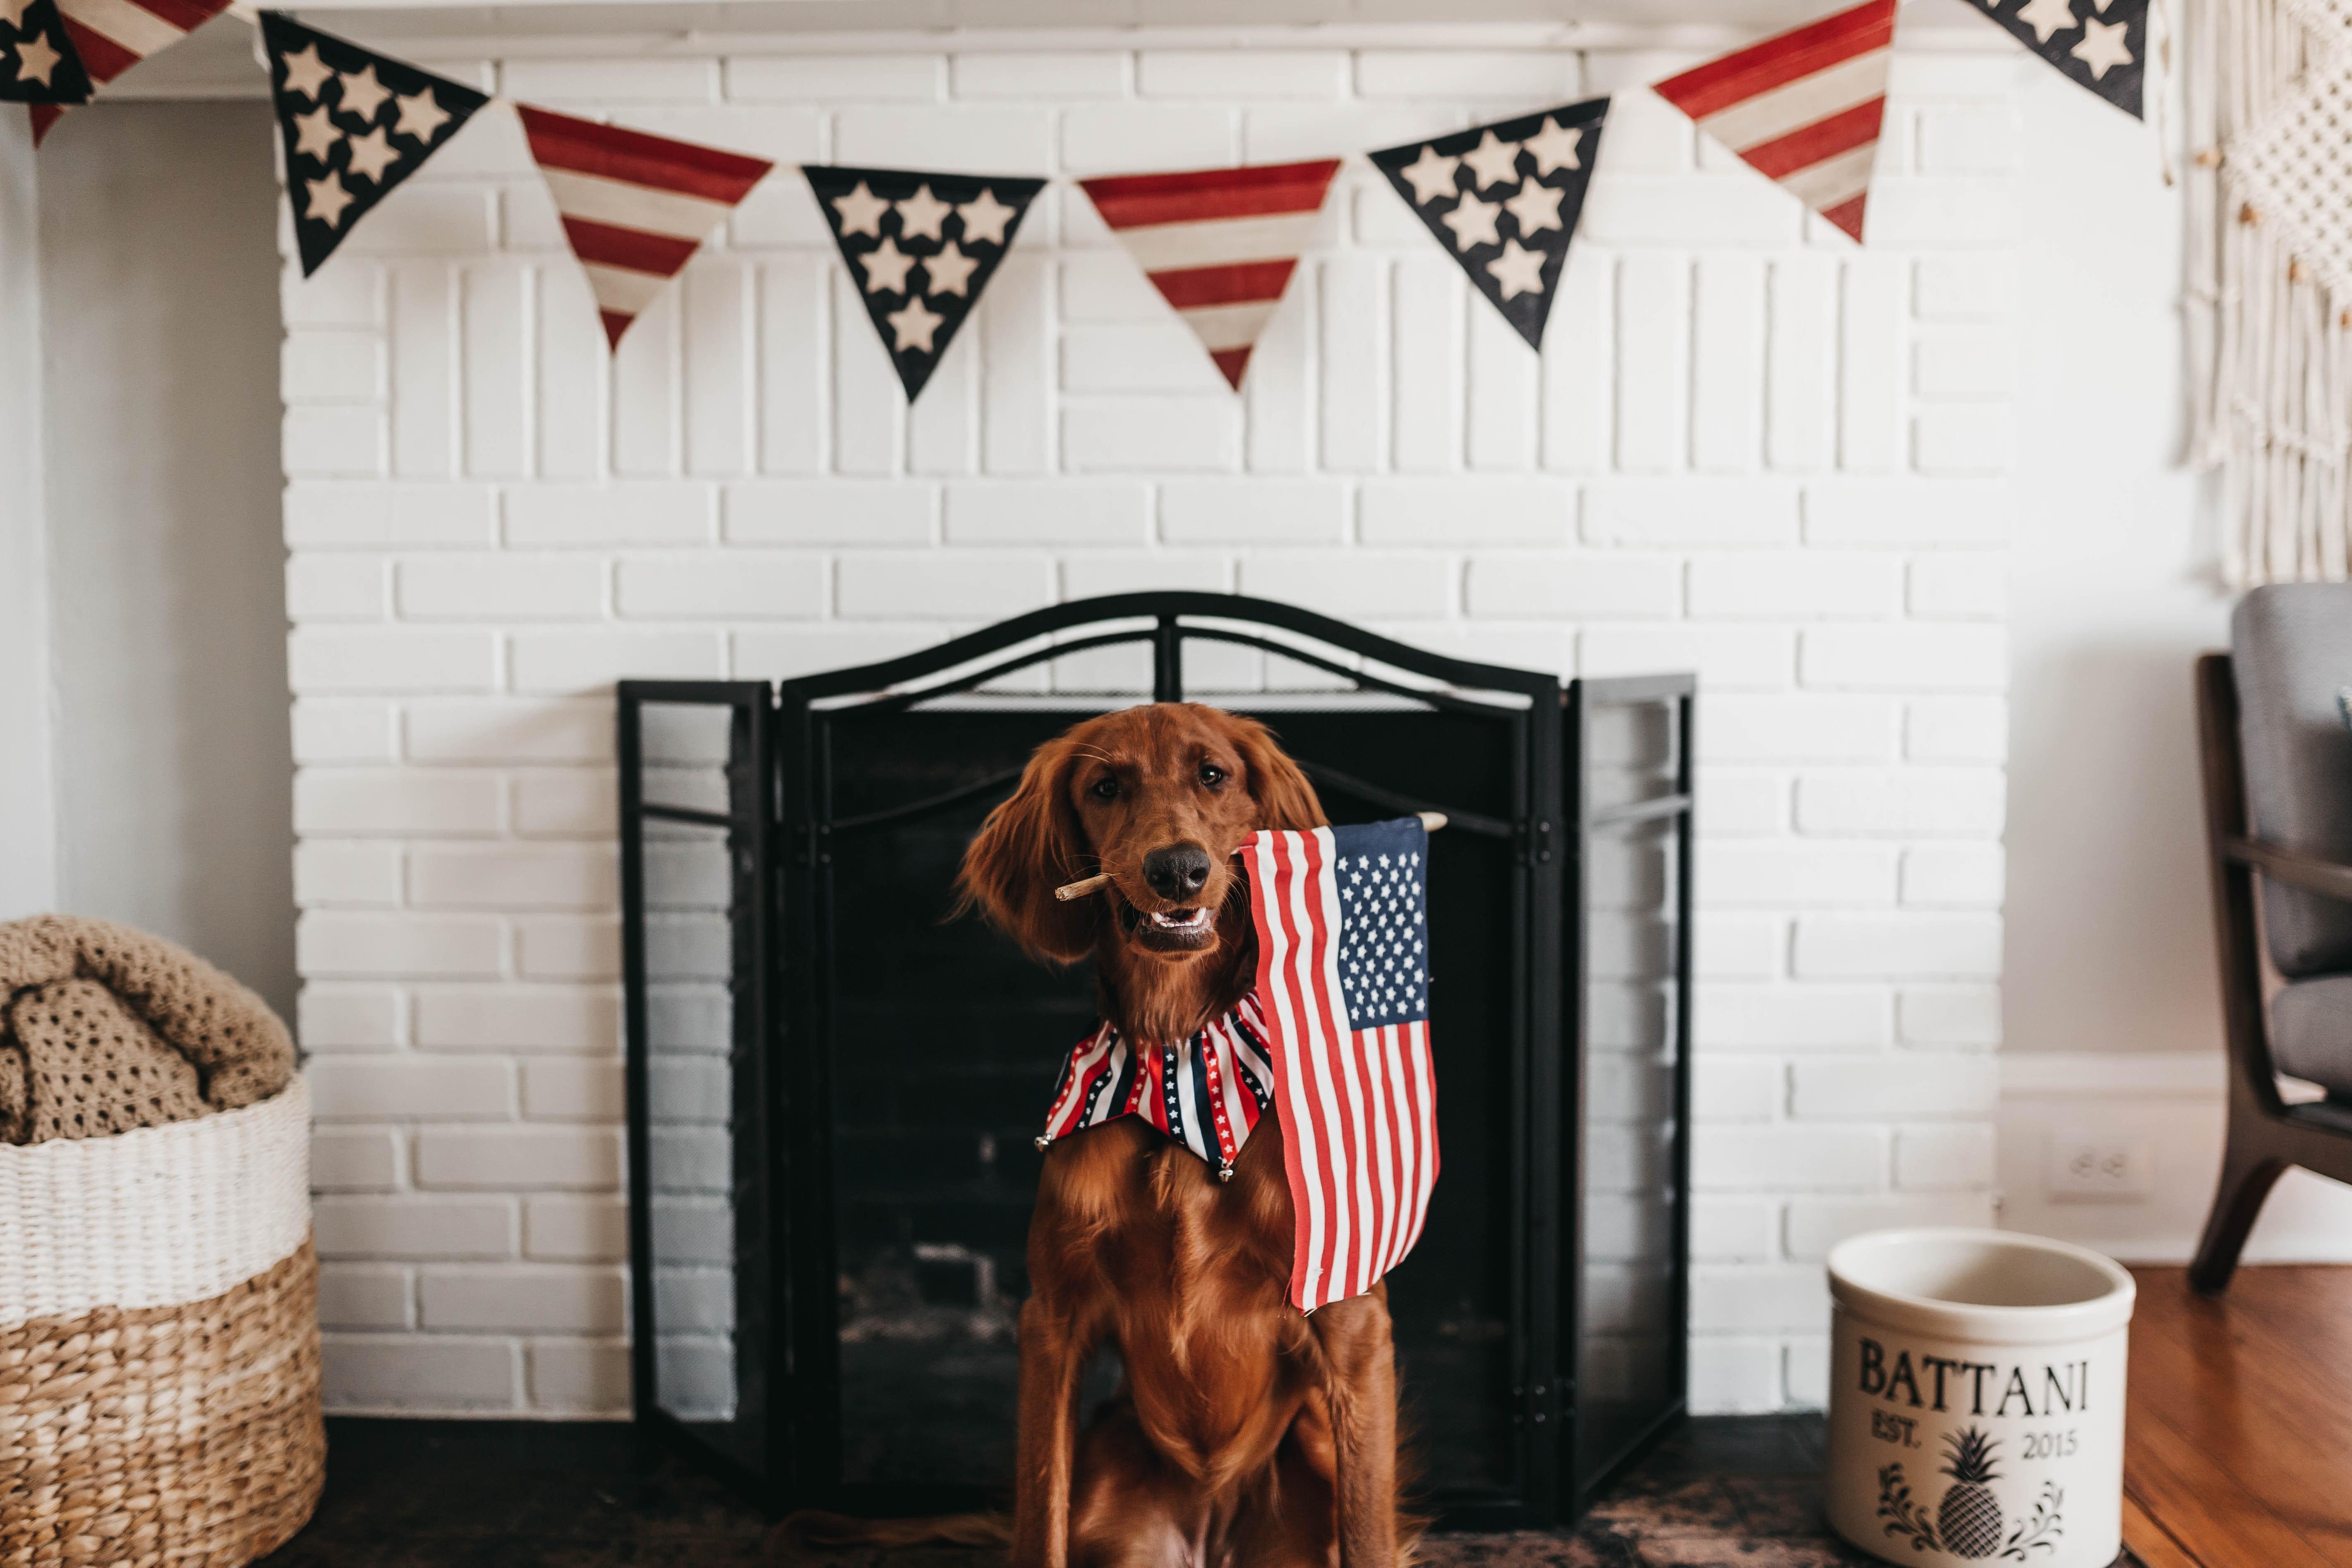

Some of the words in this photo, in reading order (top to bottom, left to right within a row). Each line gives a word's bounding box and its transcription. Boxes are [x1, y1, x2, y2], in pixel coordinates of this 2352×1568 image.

[1858, 1337, 2089, 1417] BATTANI
[1871, 1408, 1921, 1448] EST.
[2022, 1430, 2078, 1460] 2015
